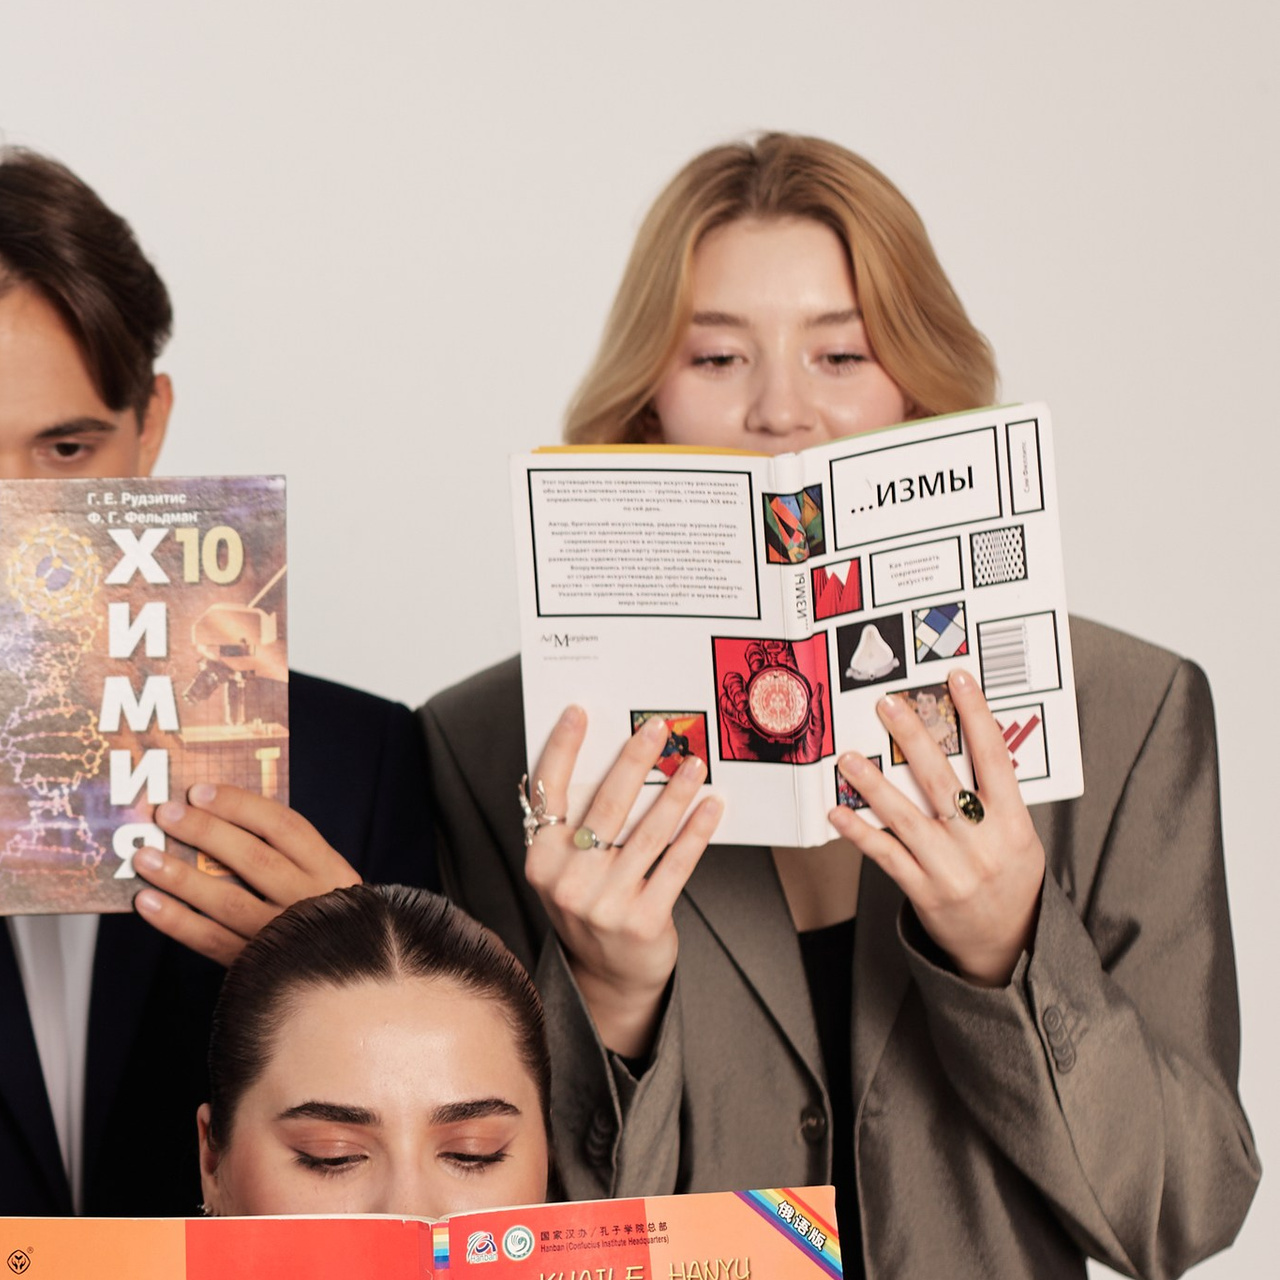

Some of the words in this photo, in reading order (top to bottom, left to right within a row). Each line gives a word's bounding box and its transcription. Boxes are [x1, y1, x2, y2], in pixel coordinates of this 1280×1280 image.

[87, 492, 100, 506] Г.
[104, 492, 118, 506] Е.
[121, 491, 187, 508] Рудзитис
[851, 466, 974, 514] ...ИЗМЫ
[87, 511, 104, 524] Ф.
[108, 511, 121, 524] Г.
[124, 511, 199, 525] Фельдман
[98, 528, 180, 880] ХИМИЯ
[175, 526, 244, 583] 10
[777, 1200, 826, 1252] 俄语版
[540, 1242, 565, 1253] Hanban
[566, 1240, 601, 1252] (Confucius
[602, 1238, 627, 1248] Institute
